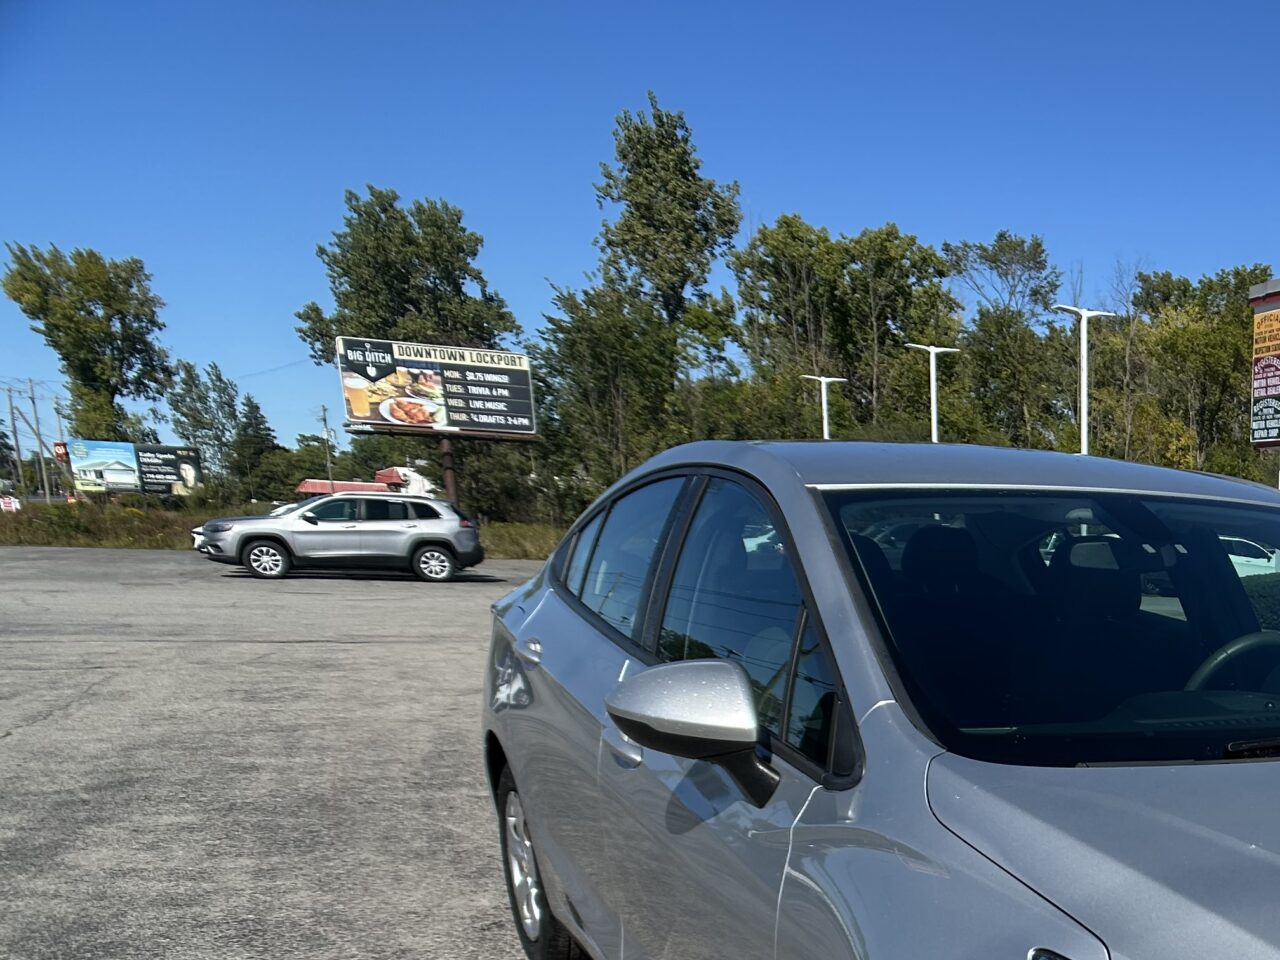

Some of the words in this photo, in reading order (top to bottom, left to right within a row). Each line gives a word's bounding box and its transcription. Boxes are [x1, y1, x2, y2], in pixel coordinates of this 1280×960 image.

[347, 349, 363, 361] BIG
[365, 351, 392, 363] DITCH
[398, 345, 466, 362] DOWNTOWN
[470, 352, 523, 367] LOCKPORT
[467, 386, 491, 396] TRIVIA
[469, 400, 484, 409] LIVE
[485, 401, 508, 411] MUSIC
